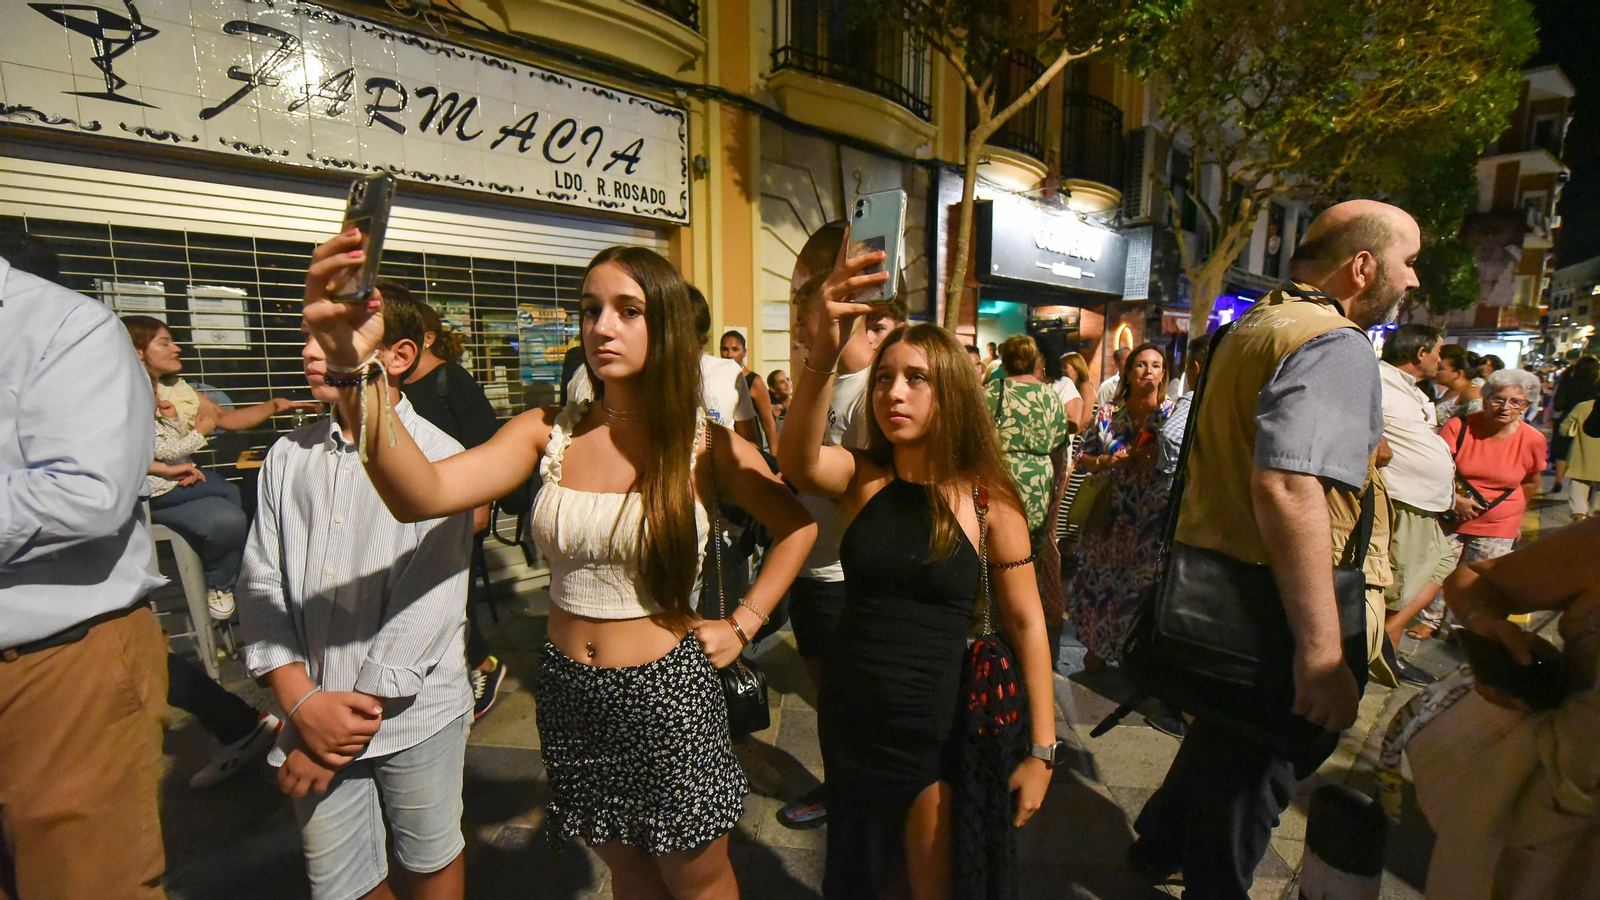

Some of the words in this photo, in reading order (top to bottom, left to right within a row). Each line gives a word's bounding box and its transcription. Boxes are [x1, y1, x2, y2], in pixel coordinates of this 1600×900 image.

[199, 20, 644, 175] FARMACIA
[555, 170, 586, 193] LDO.
[614, 181, 666, 206] ROSADO
